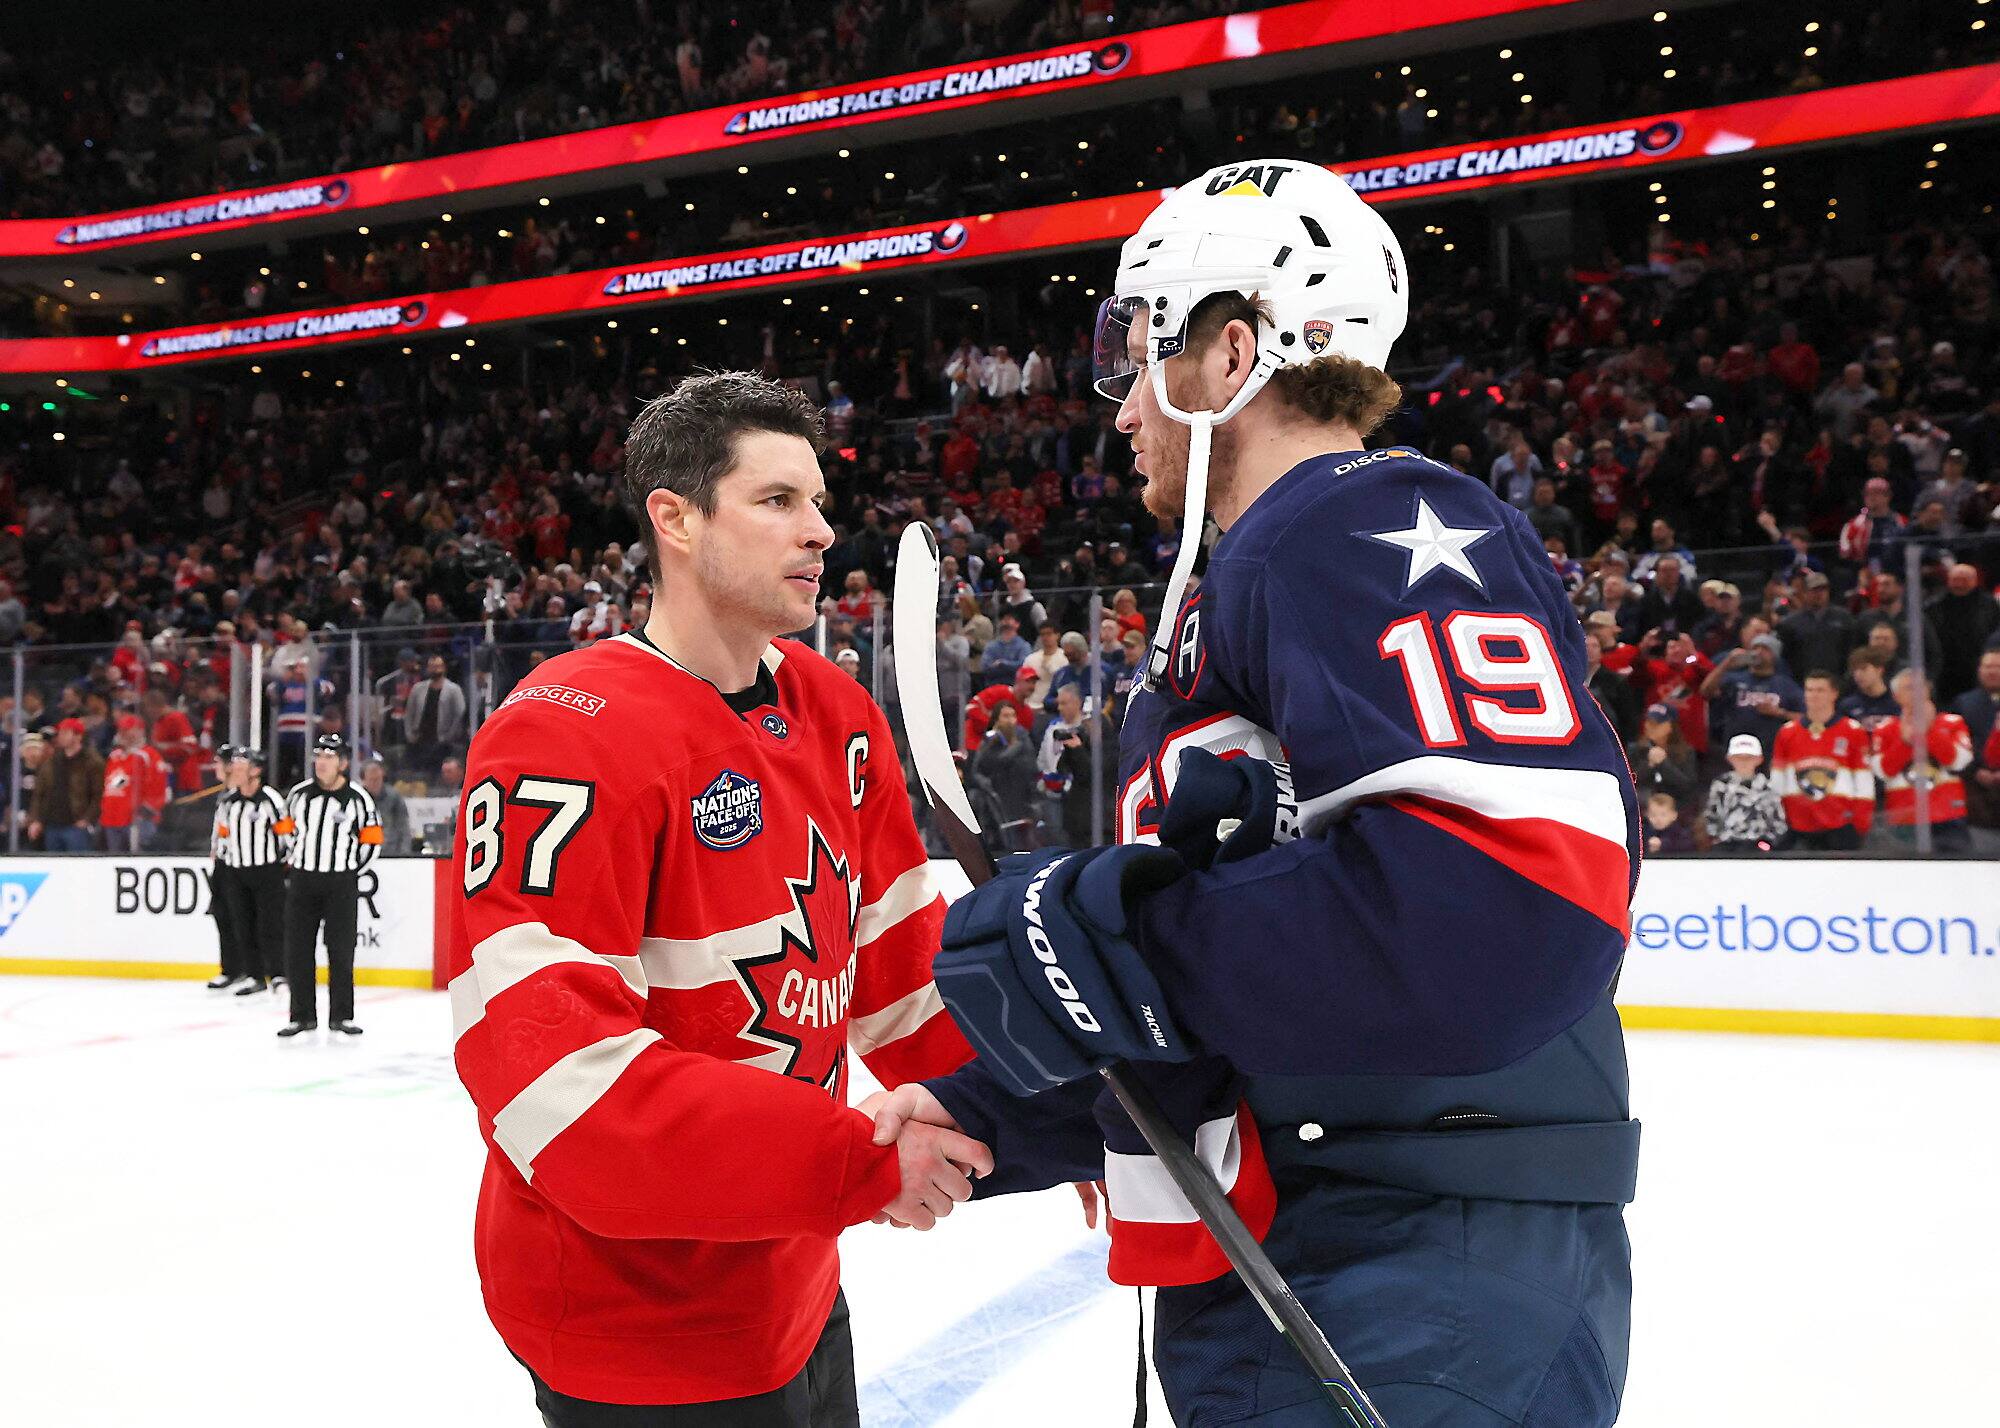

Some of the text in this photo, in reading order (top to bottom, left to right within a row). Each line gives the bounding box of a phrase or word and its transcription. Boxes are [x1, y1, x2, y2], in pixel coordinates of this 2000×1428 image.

[747, 96, 840, 131] NATIONS
[841, 78, 943, 114] FACE-OFF
[943, 51, 1093, 97] CHAMPIONS
[1457, 129, 1637, 178] CHAMPIONS
[1205, 166, 1294, 197] CAT
[624, 264, 708, 293] NATIONS
[708, 252, 801, 281] FACE-OFF
[800, 231, 935, 269] CHAMPIONS
[525, 687, 599, 712] ROGERS
[1377, 610, 1583, 748] 19
[845, 731, 870, 811] C
[692, 782, 760, 818] NATIONS
[699, 800, 758, 830] FACE-OFF
[464, 773, 596, 900] 87
[719, 822, 738, 835] 2025
[1635, 904, 2000, 955] eetboston.
